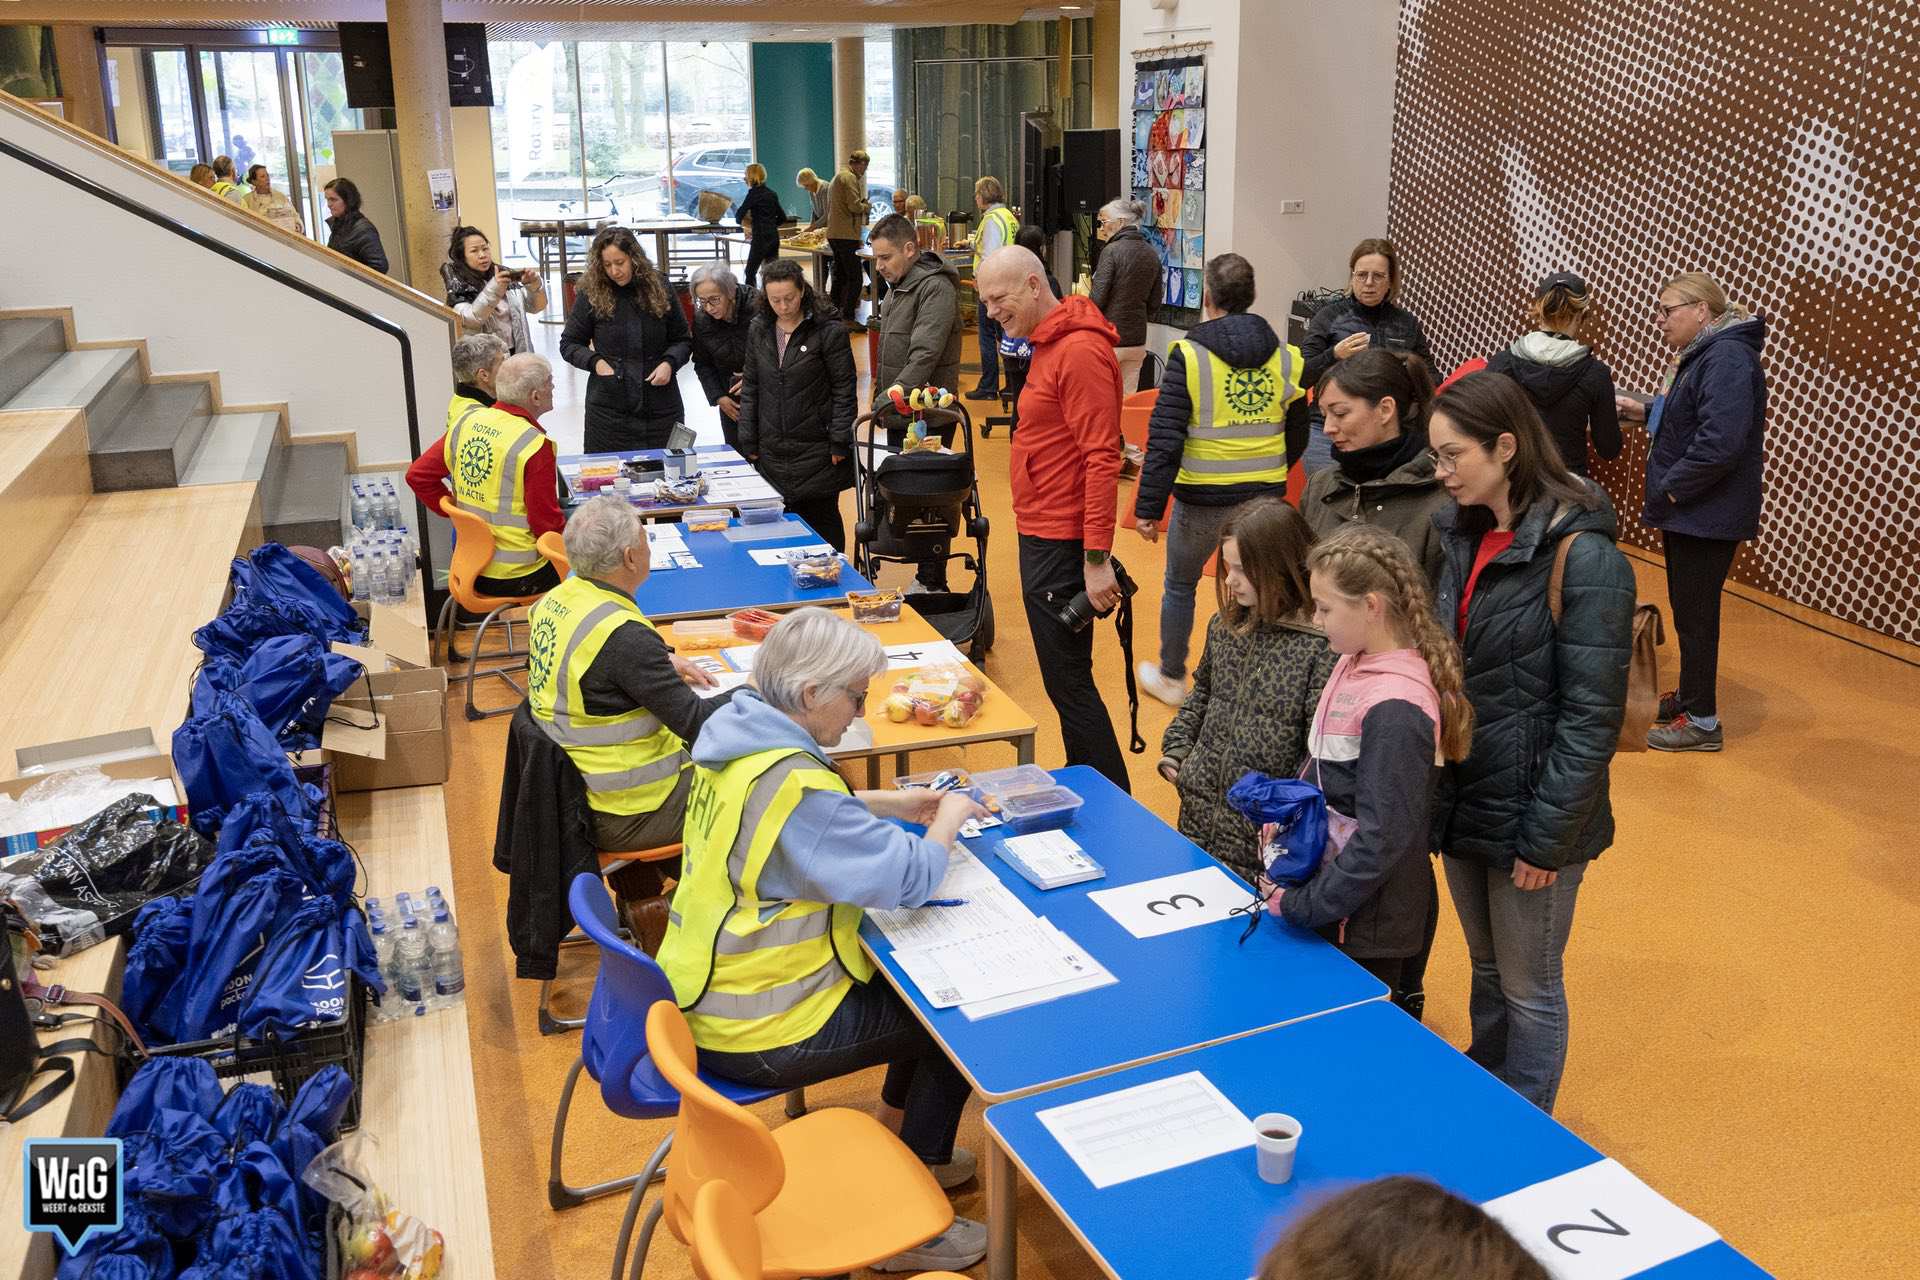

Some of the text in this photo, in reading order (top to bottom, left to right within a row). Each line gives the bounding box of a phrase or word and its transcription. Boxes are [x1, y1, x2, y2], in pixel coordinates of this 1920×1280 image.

[471, 422, 502, 439] ROTARY
[465, 488, 487, 503] ACTIE
[543, 597, 572, 620] ROTARY
[887, 651, 924, 661] 4
[1146, 893, 1206, 917] 3
[1546, 1207, 1631, 1255] 2
